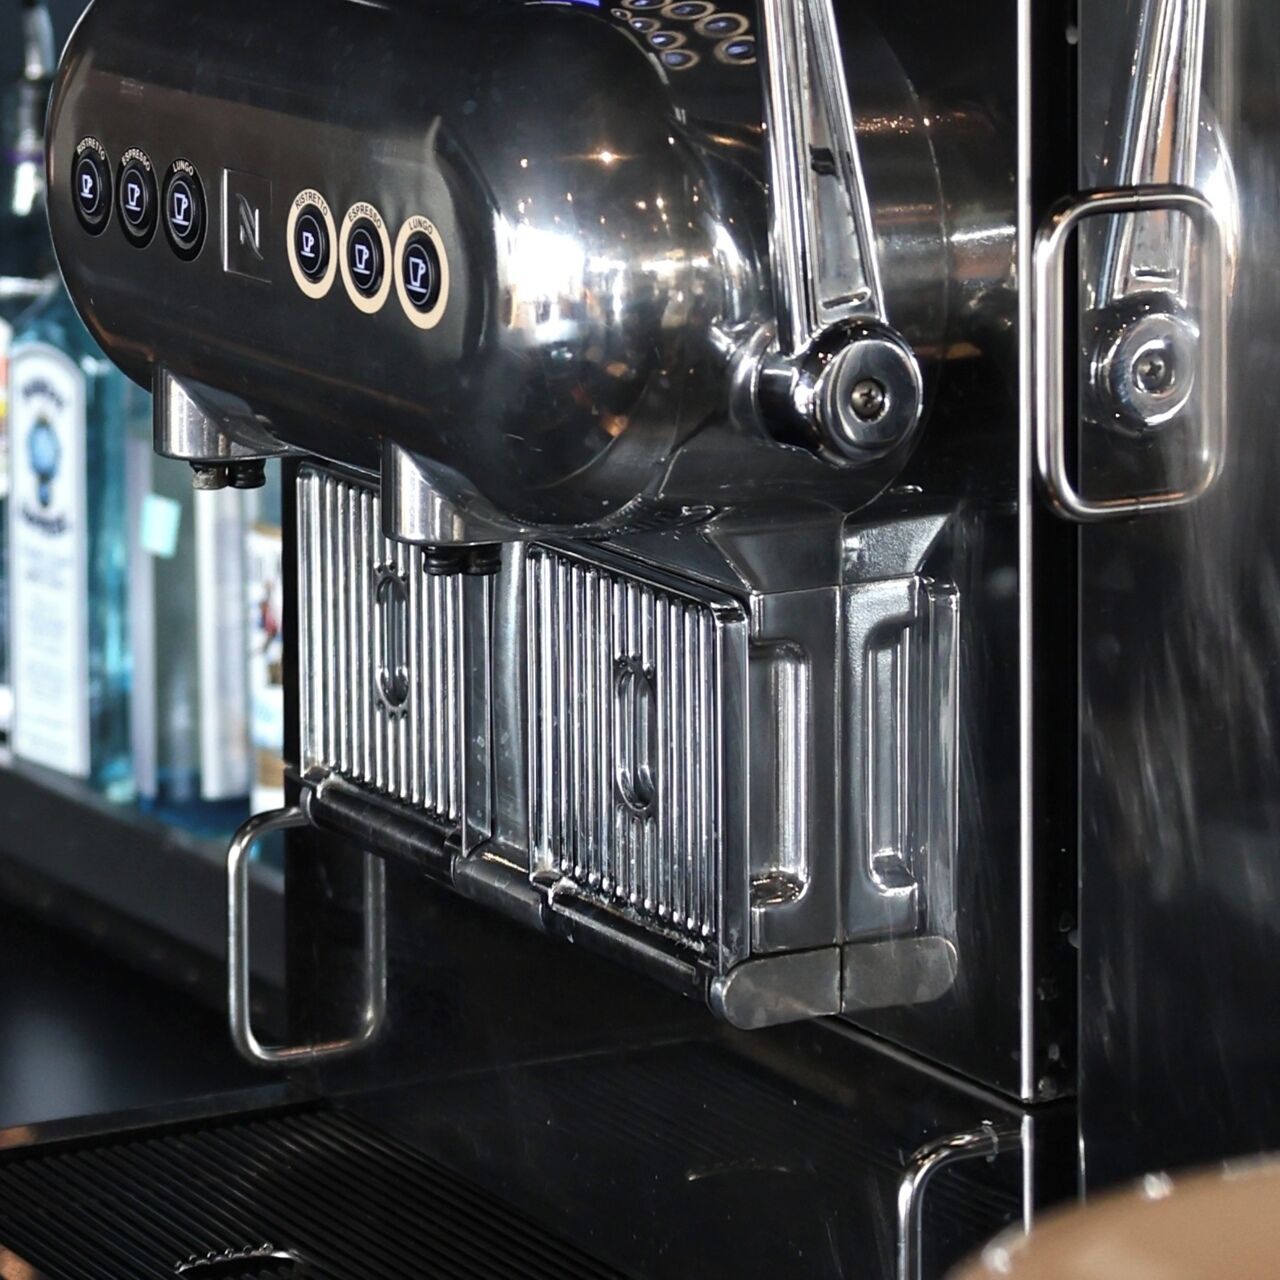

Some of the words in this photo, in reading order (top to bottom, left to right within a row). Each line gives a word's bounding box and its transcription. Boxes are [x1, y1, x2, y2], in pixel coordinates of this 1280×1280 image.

[76, 137, 106, 161] RISTRETTO
[121, 148, 151, 172] ESPRESSO
[172, 160, 194, 176] LUNGO
[294, 191, 328, 217] RISTRETTO
[347, 204, 382, 229] ESPRESSO
[408, 219, 433, 235] LUNGO
